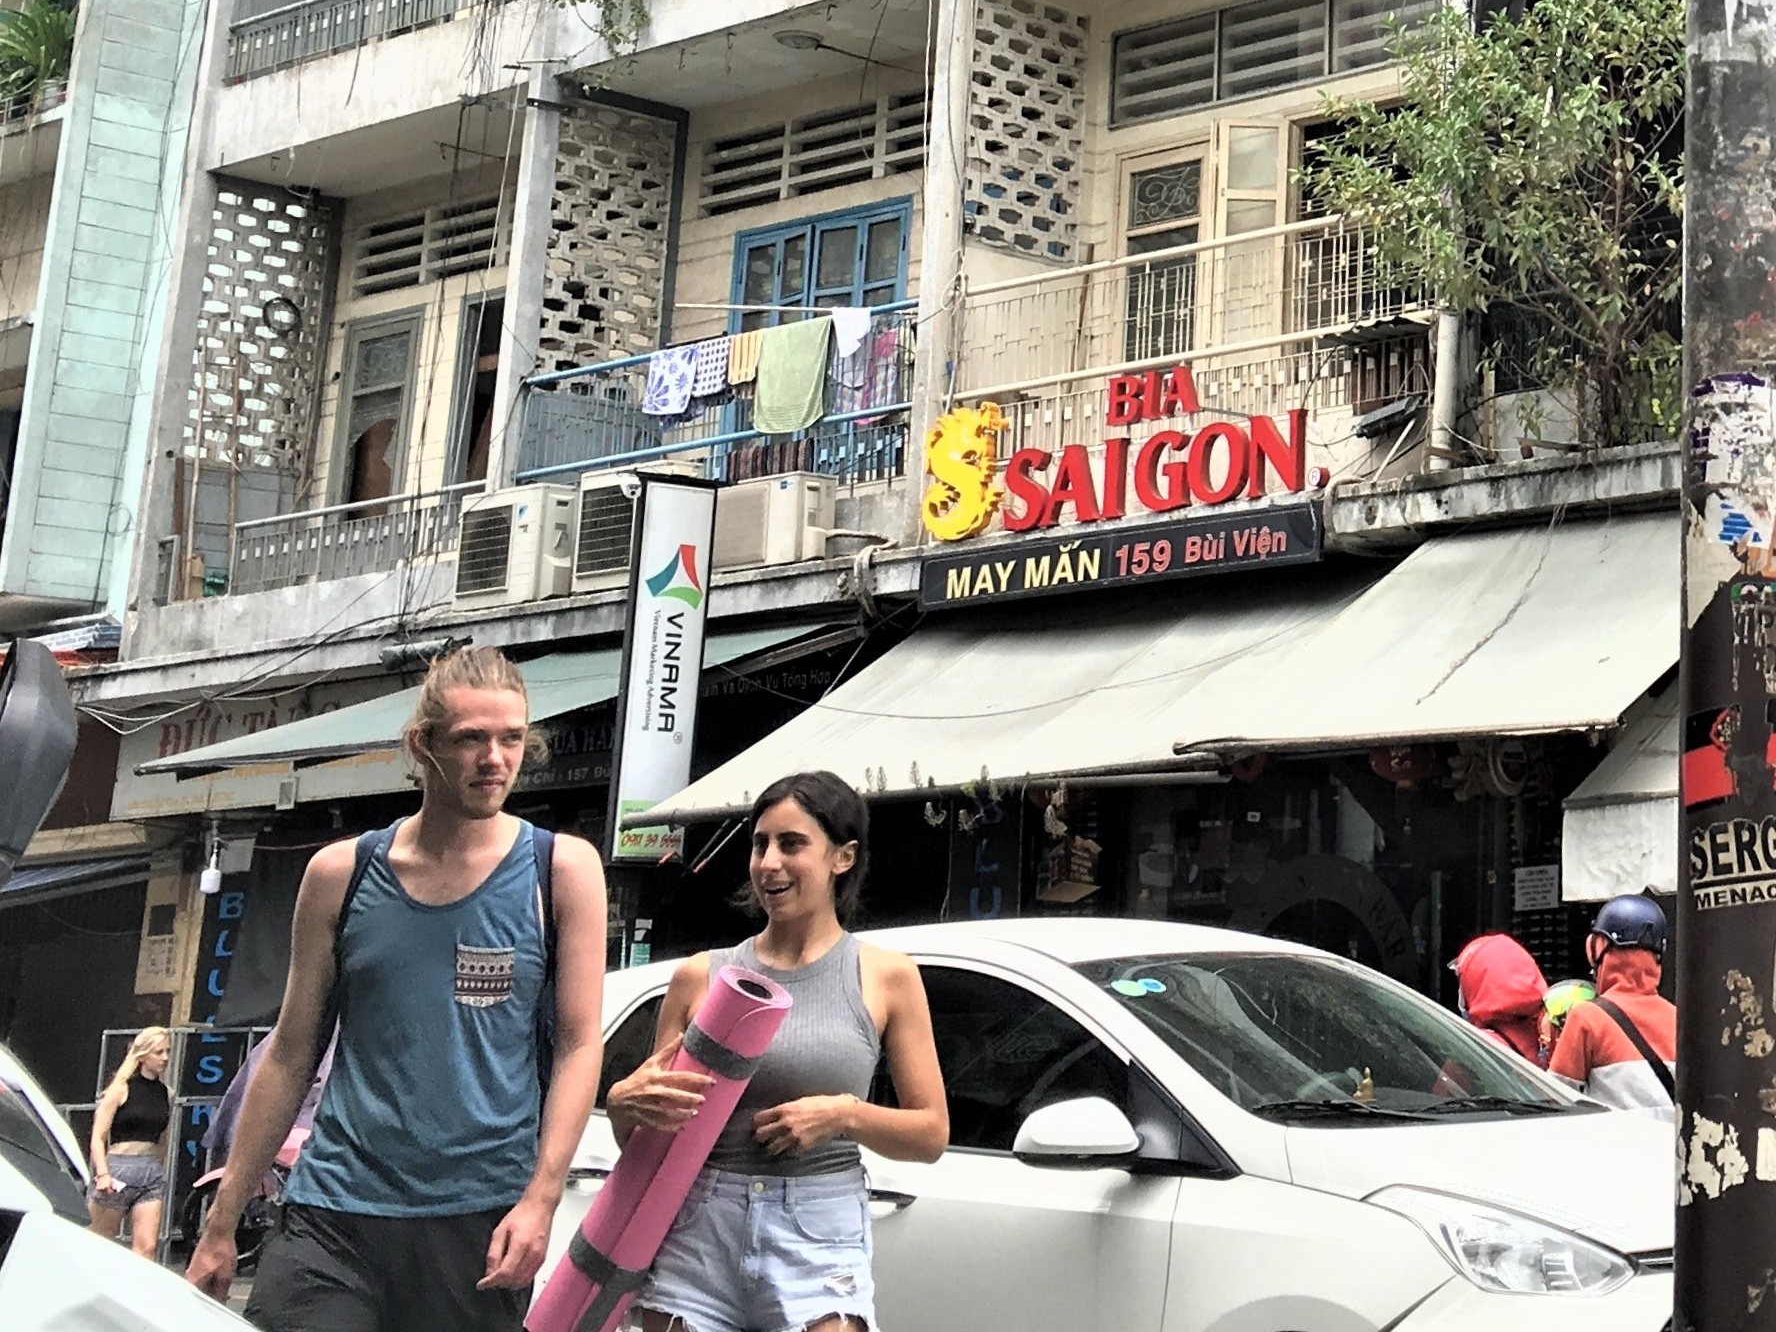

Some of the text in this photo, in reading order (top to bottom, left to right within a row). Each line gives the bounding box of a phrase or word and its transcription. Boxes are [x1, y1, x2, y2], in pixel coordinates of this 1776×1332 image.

[1106, 364, 1201, 427] BIA
[1002, 408, 1308, 532] SAIGON
[946, 527, 1288, 600] MAY MẮN 159 Bùi Viện
[657, 612, 685, 732] VINAMA
